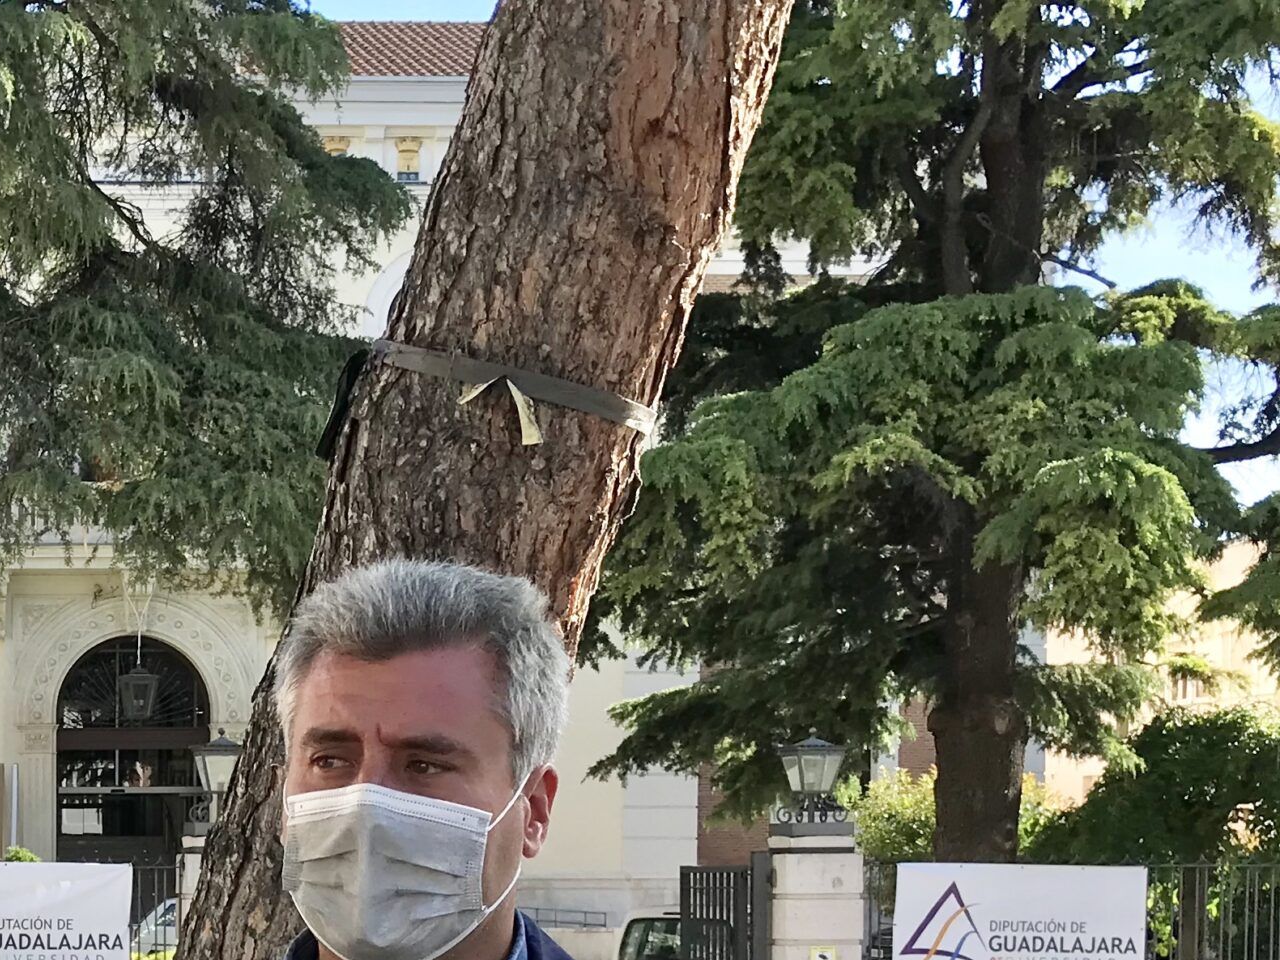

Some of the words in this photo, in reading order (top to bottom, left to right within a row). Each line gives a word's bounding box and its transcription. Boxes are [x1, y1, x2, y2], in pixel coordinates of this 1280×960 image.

[57, 918, 73, 930] DE
[989, 918, 1066, 933] DIPUTACIÓN
[1070, 921, 1087, 933] DE
[988, 935, 1137, 954] GUADALAJARA
